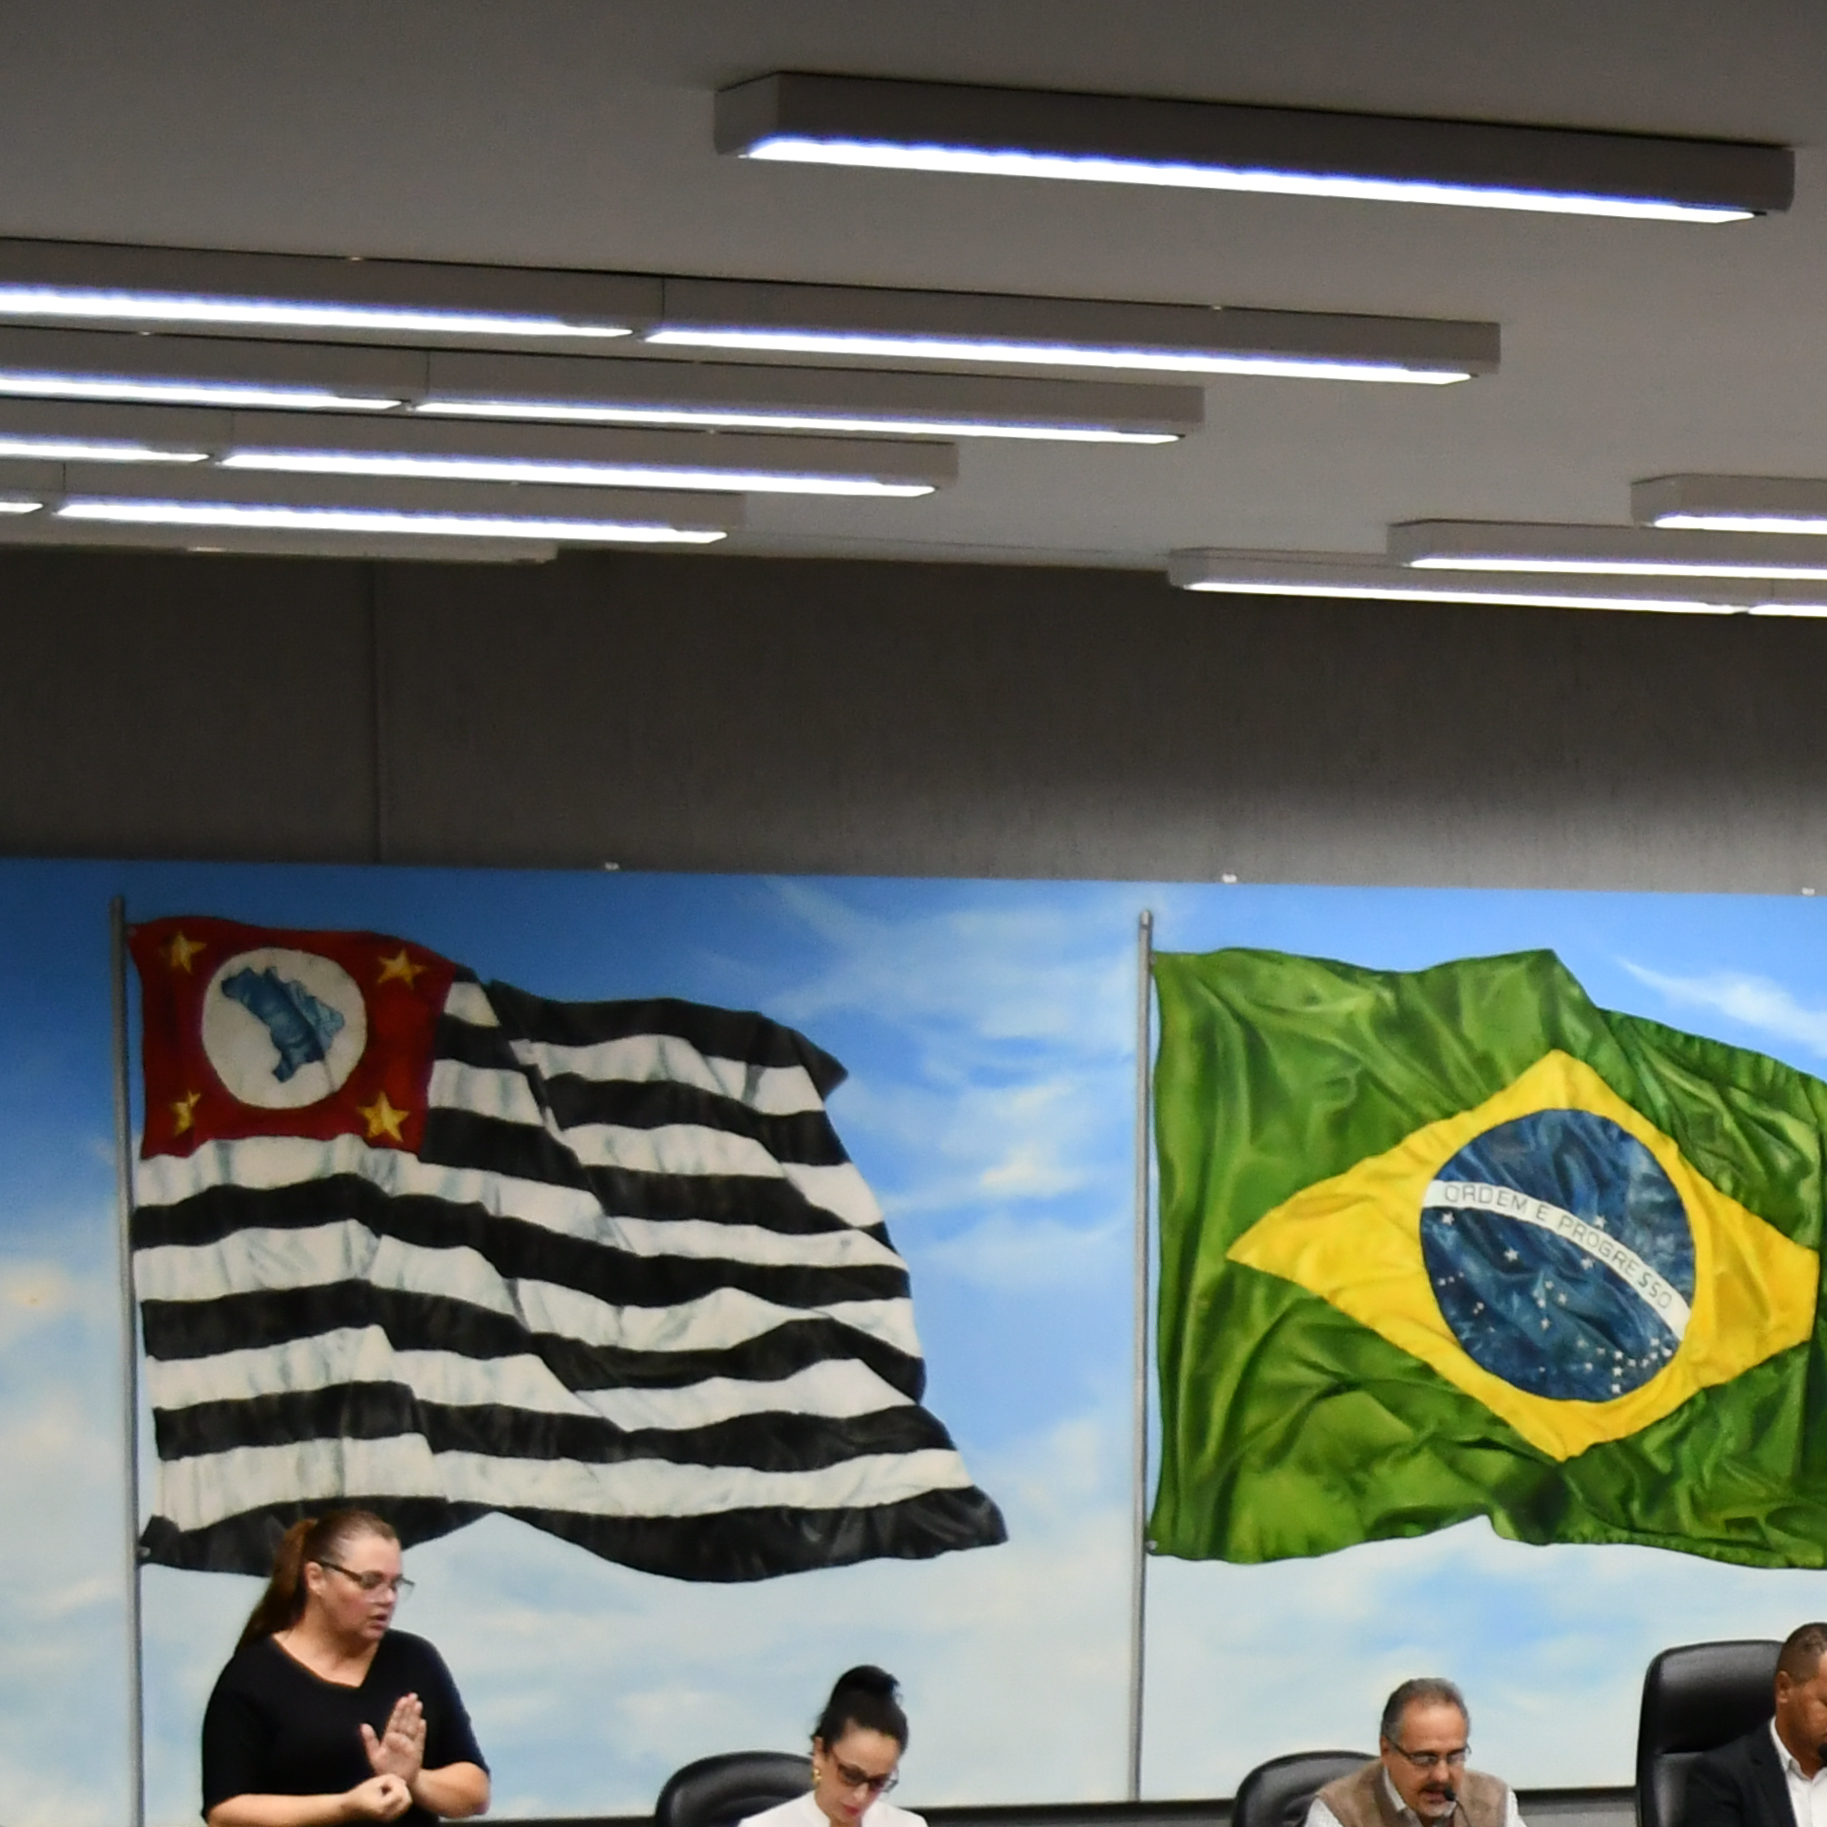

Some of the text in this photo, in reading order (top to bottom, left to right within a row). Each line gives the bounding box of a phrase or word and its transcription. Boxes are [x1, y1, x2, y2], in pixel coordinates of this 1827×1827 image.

[1444, 1184, 1673, 1309] ORDEM E PROGRESSO
